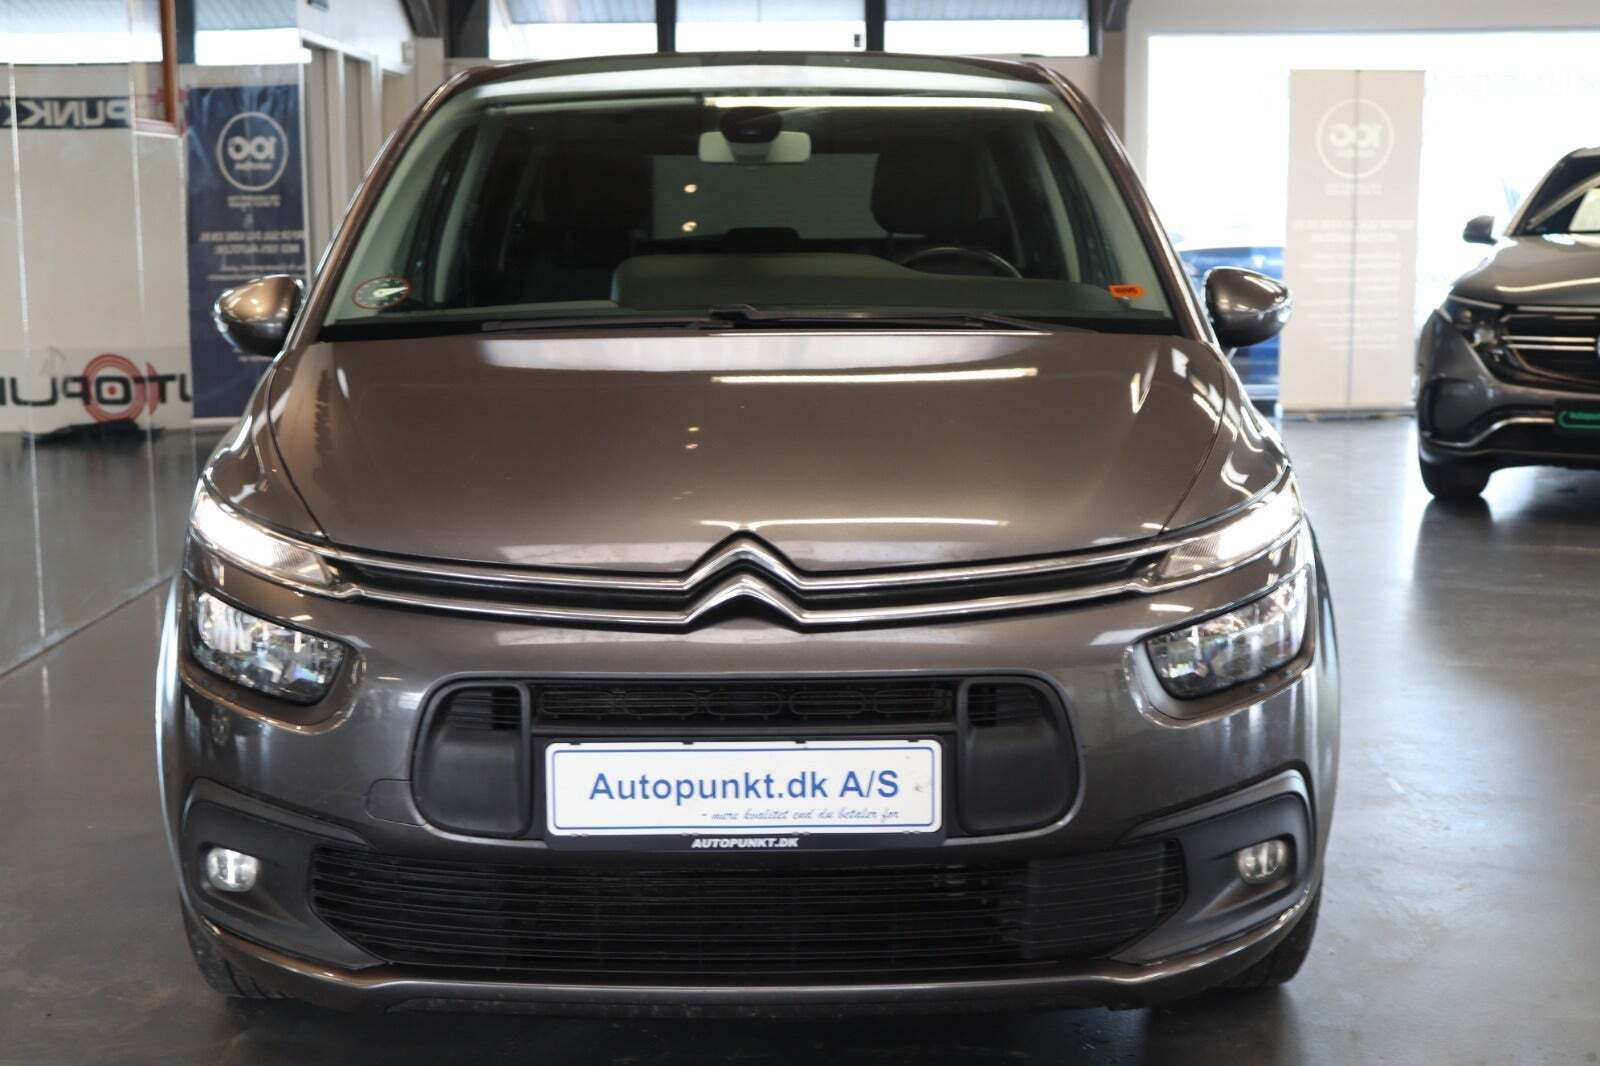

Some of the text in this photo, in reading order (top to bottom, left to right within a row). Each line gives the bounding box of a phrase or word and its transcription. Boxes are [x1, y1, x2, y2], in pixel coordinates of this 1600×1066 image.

[589, 769, 899, 806] Autopunkt.dk A/S
[691, 838, 799, 849] AUTOPUNKT.DK
